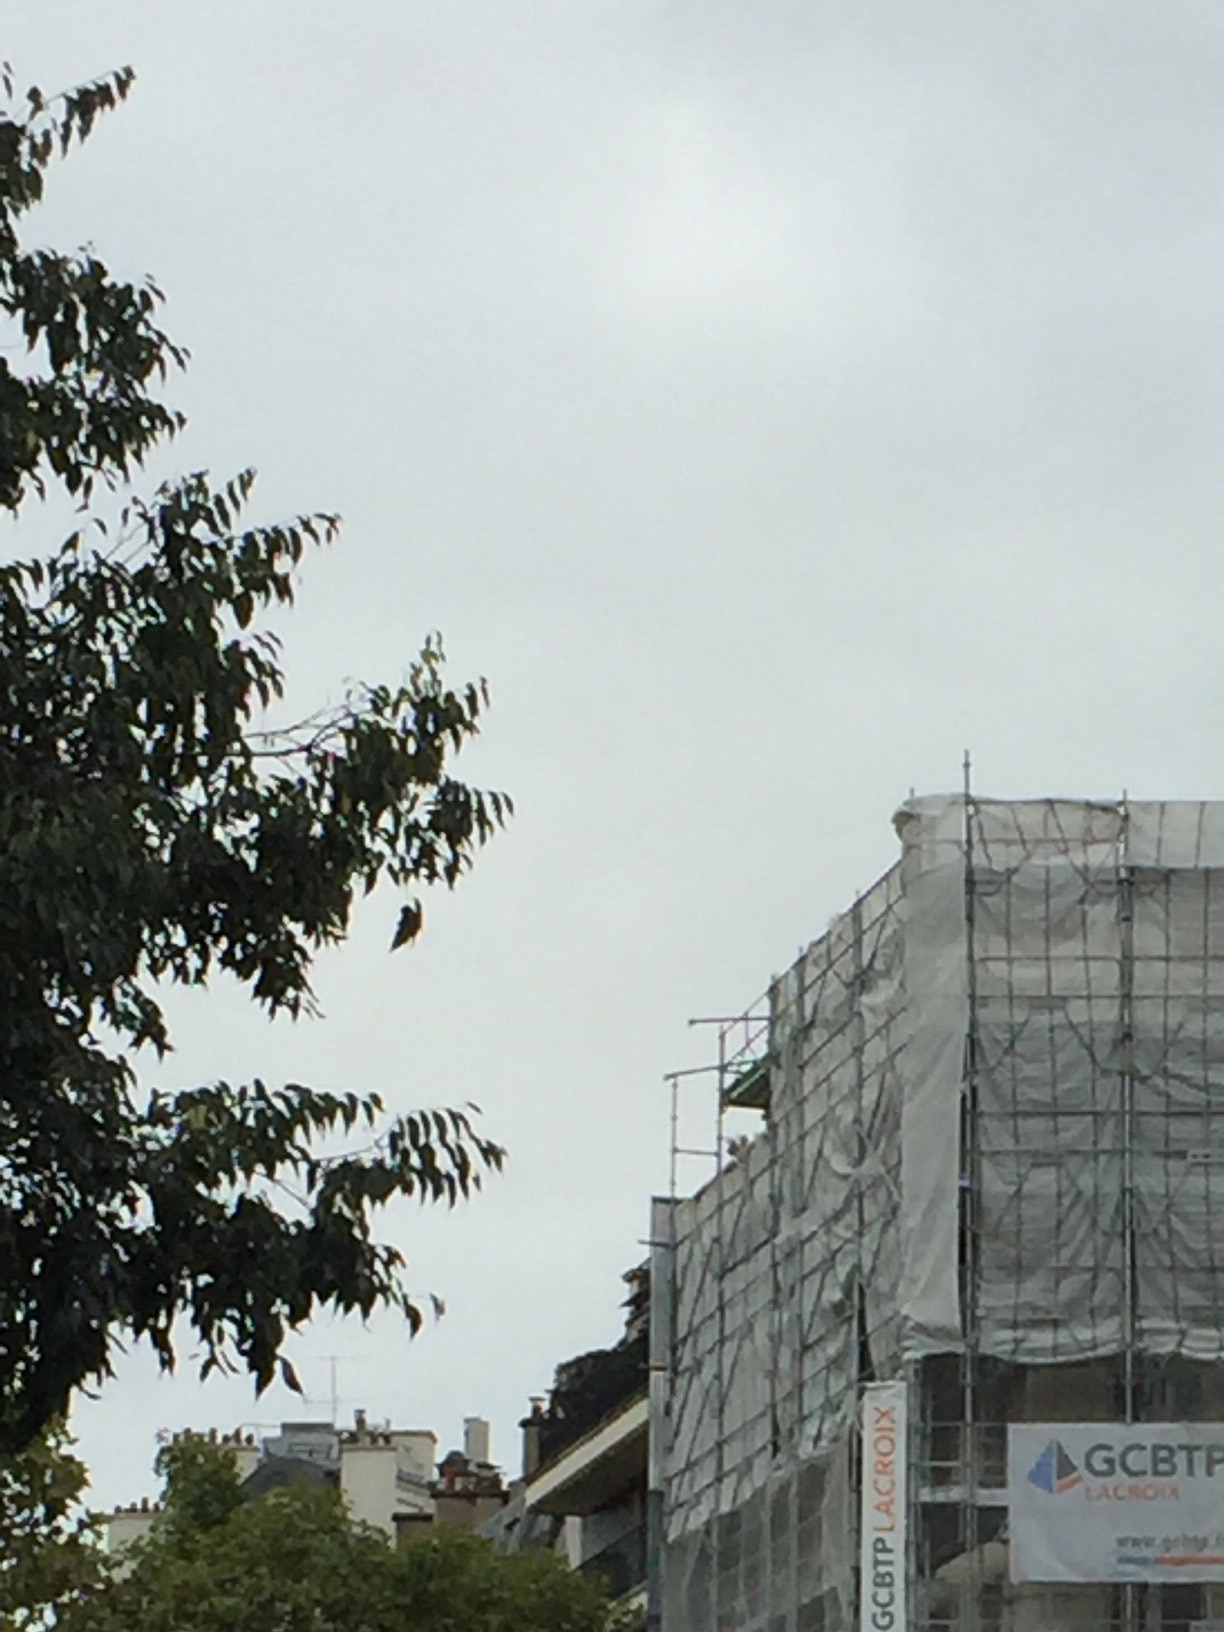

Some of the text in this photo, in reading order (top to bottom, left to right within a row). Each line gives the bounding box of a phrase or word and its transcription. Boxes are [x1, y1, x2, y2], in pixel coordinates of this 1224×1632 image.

[871, 1407, 896, 1631] GCBTP LACROIX
[1085, 1483, 1180, 1501] LACROIX
